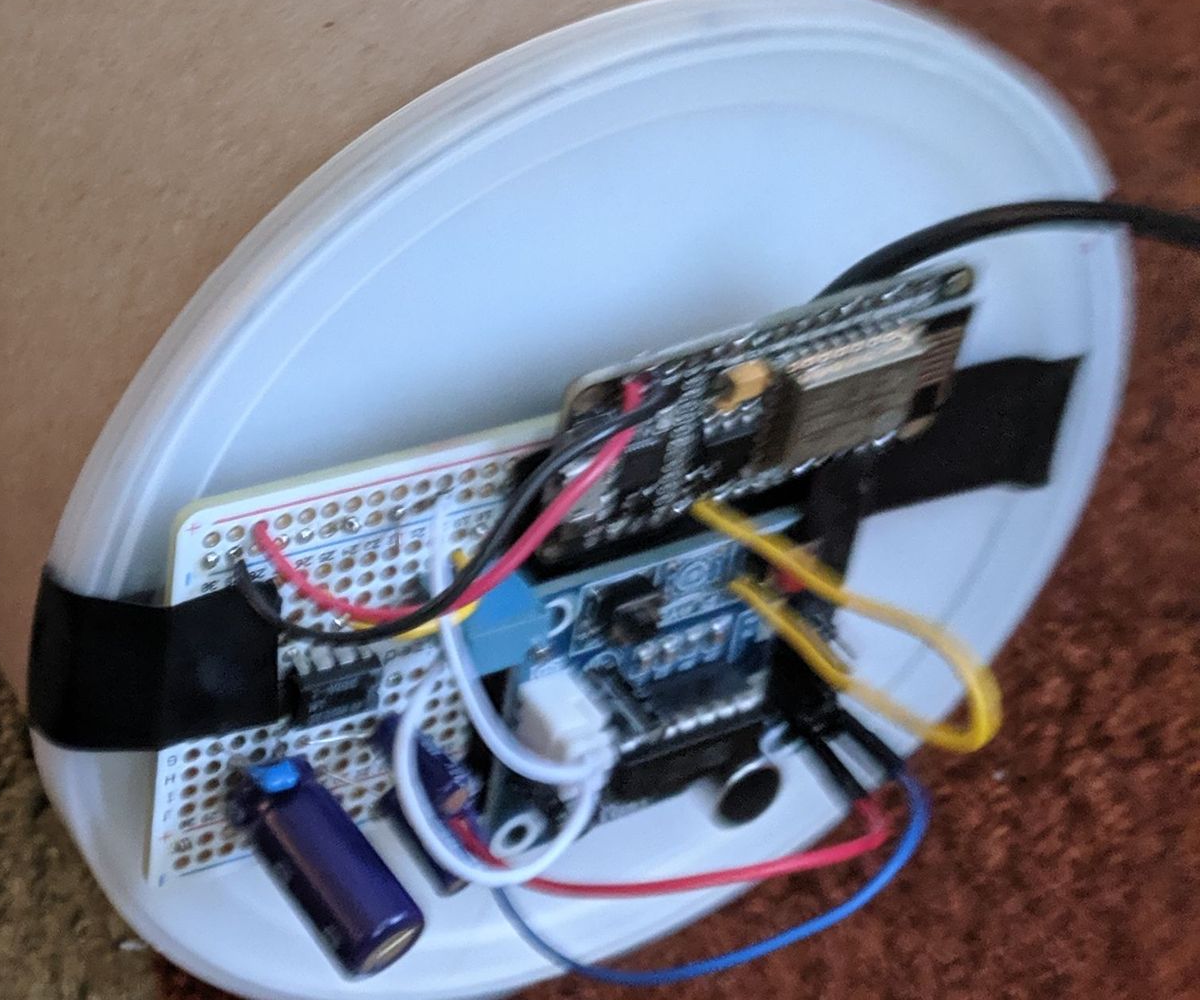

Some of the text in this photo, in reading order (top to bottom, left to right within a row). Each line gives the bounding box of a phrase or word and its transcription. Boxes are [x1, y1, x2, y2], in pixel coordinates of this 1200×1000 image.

[319, 550, 337, 562] 25
[201, 580, 218, 593] 30
[164, 773, 176, 786] H
